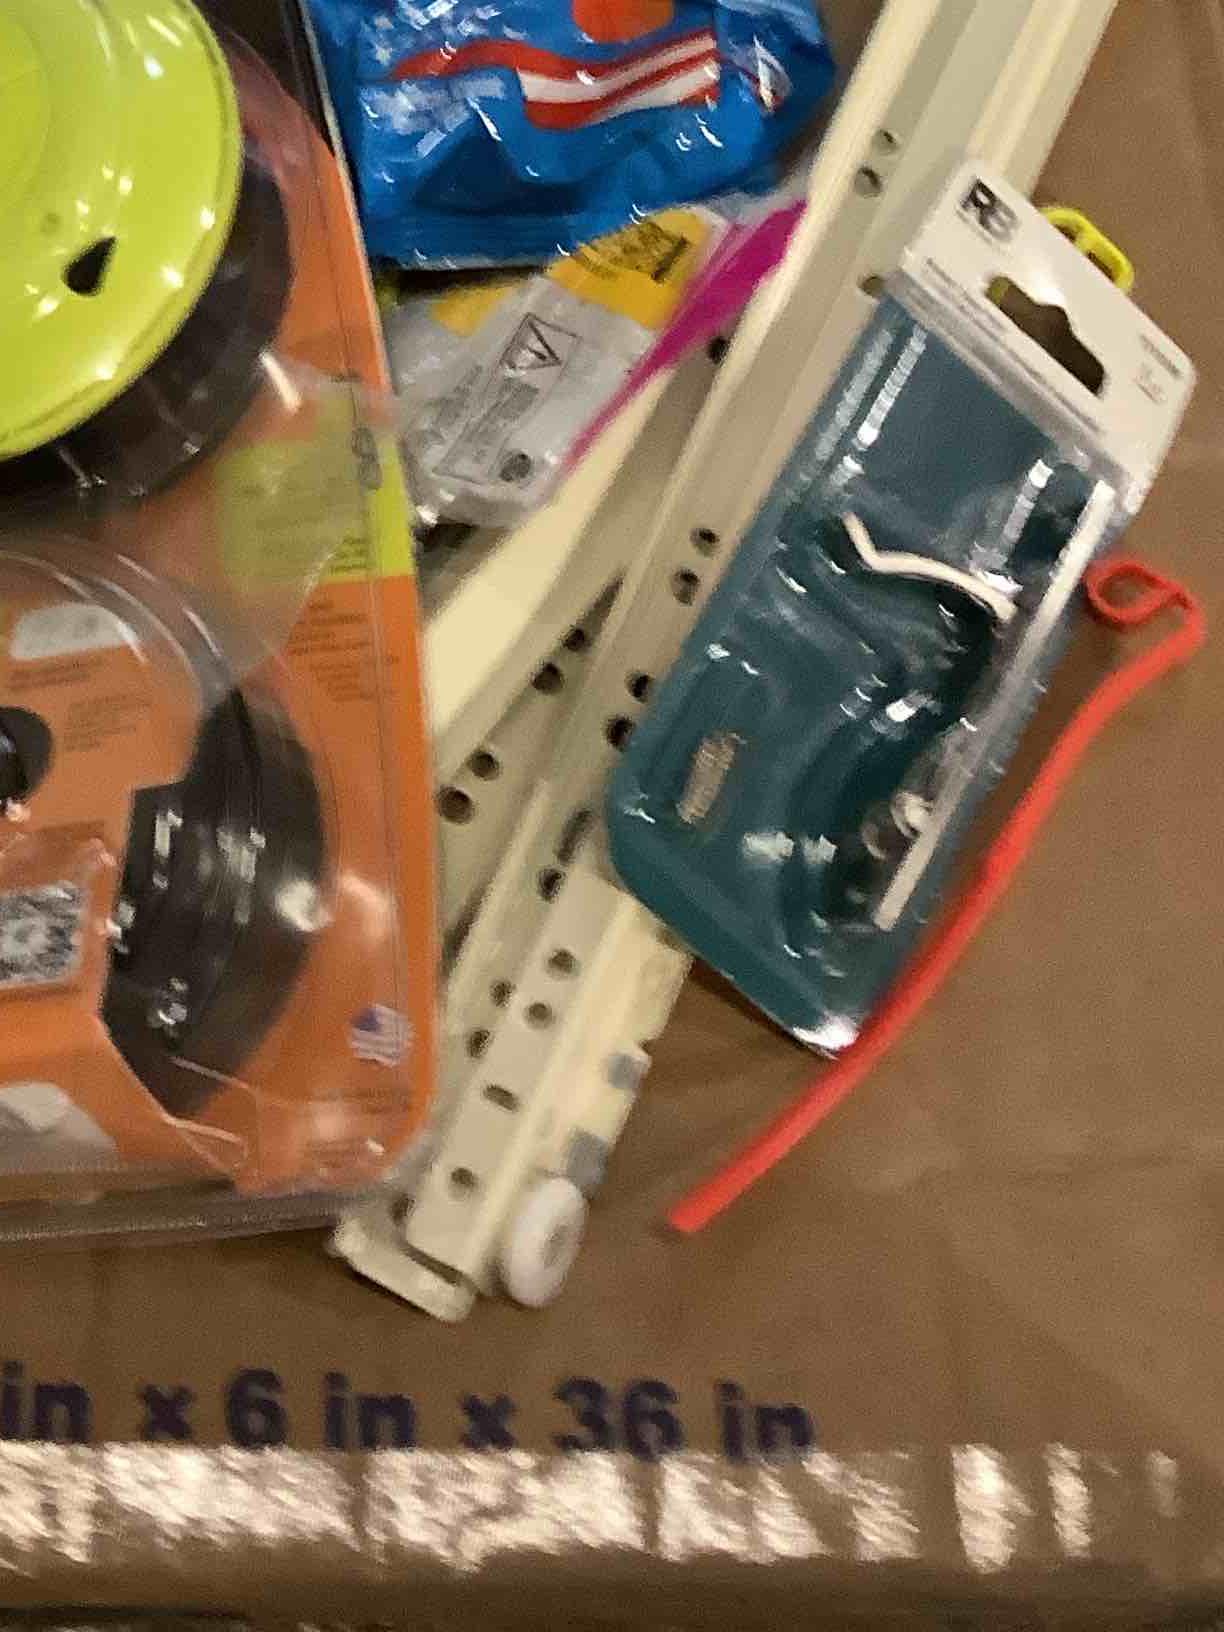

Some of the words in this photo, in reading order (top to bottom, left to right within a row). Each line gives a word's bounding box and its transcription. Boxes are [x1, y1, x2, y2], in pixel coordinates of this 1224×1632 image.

[138, 1381, 195, 1444] x
[225, 1367, 288, 1449] 6
[323, 1370, 416, 1451] in
[457, 1389, 516, 1452] x
[551, 1375, 685, 1459] 36
[717, 1380, 818, 1468] in
